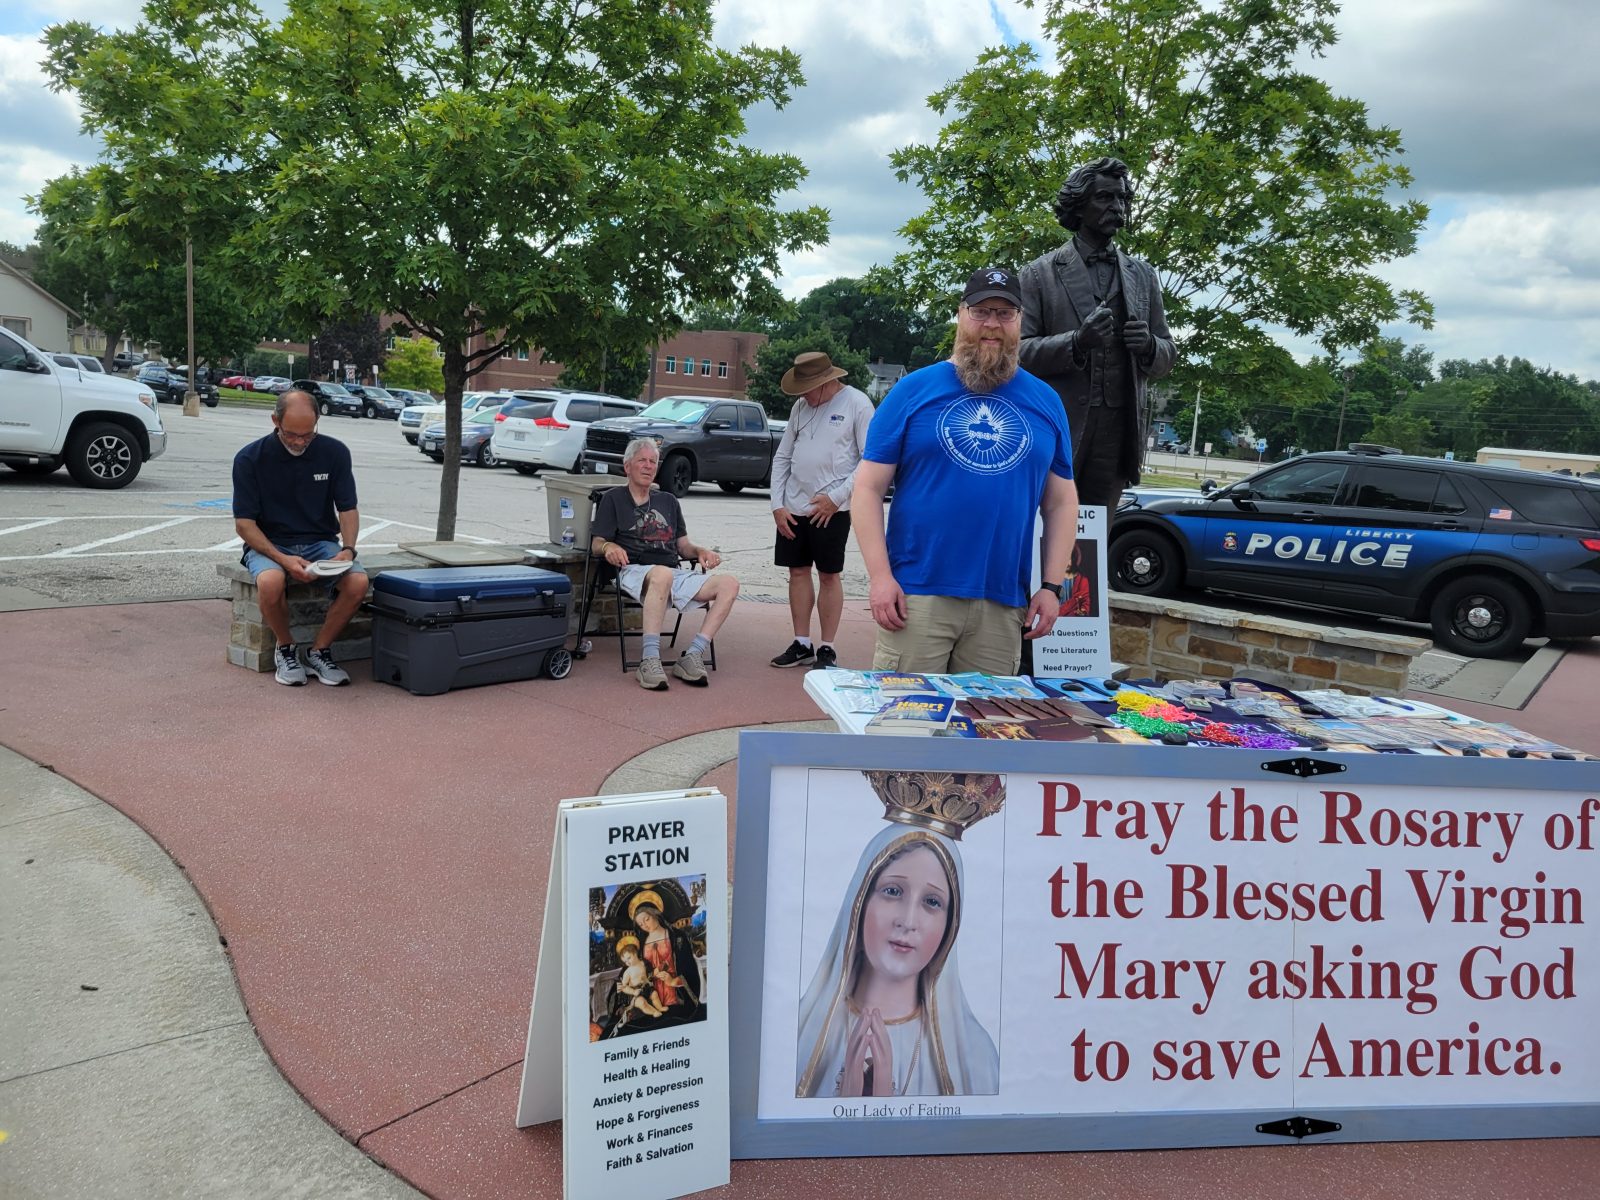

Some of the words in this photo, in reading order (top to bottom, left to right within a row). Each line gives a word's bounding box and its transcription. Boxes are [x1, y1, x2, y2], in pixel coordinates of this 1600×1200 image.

[1345, 528, 1417, 540] LIBERTY
[1245, 533, 1413, 568] POLICE
[1057, 629, 1098, 637] Questions?
[1061, 646, 1098, 654] Literature
[1064, 664, 1093, 673] Prayer?
[608, 820, 685, 845] PRAYER
[1036, 781, 1184, 855] Pray
[1207, 788, 1299, 843] the
[1319, 791, 1523, 864] Rosary
[1544, 798, 1600, 851] of
[604, 846, 690, 873] STATION
[1048, 862, 1144, 919] the
[1165, 864, 1385, 923] Blessed
[1405, 869, 1585, 939] Virgin
[1054, 942, 1226, 1015] Mary
[1248, 944, 1438, 1015] asking
[1458, 946, 1577, 1000] God
[604, 1047, 639, 1062] Family
[642, 1045, 649, 1055] &
[652, 1037, 690, 1053] Friends
[1071, 1028, 1130, 1082] to
[1152, 1039, 1281, 1081] save
[1299, 1021, 1562, 1078] America.
[603, 1067, 638, 1083] Health
[641, 1065, 648, 1075] &
[651, 1058, 690, 1073] Healing
[593, 1091, 633, 1108] Anxiety
[636, 1088, 643, 1098] &
[646, 1077, 703, 1096] Depression
[596, 1117, 624, 1131] Hope
[627, 1113, 634, 1123] &
[637, 1100, 700, 1120] Forgiveness
[833, 1104, 859, 1117] Our
[863, 1104, 895, 1117] Lady
[900, 1103, 914, 1116] of
[918, 1103, 961, 1116] Fatima
[606, 1135, 634, 1150] Work
[637, 1132, 644, 1143] &
[647, 1123, 693, 1140] Finances
[606, 1155, 633, 1171] Faith
[635, 1153, 643, 1163] &
[646, 1142, 694, 1161] Salvation
